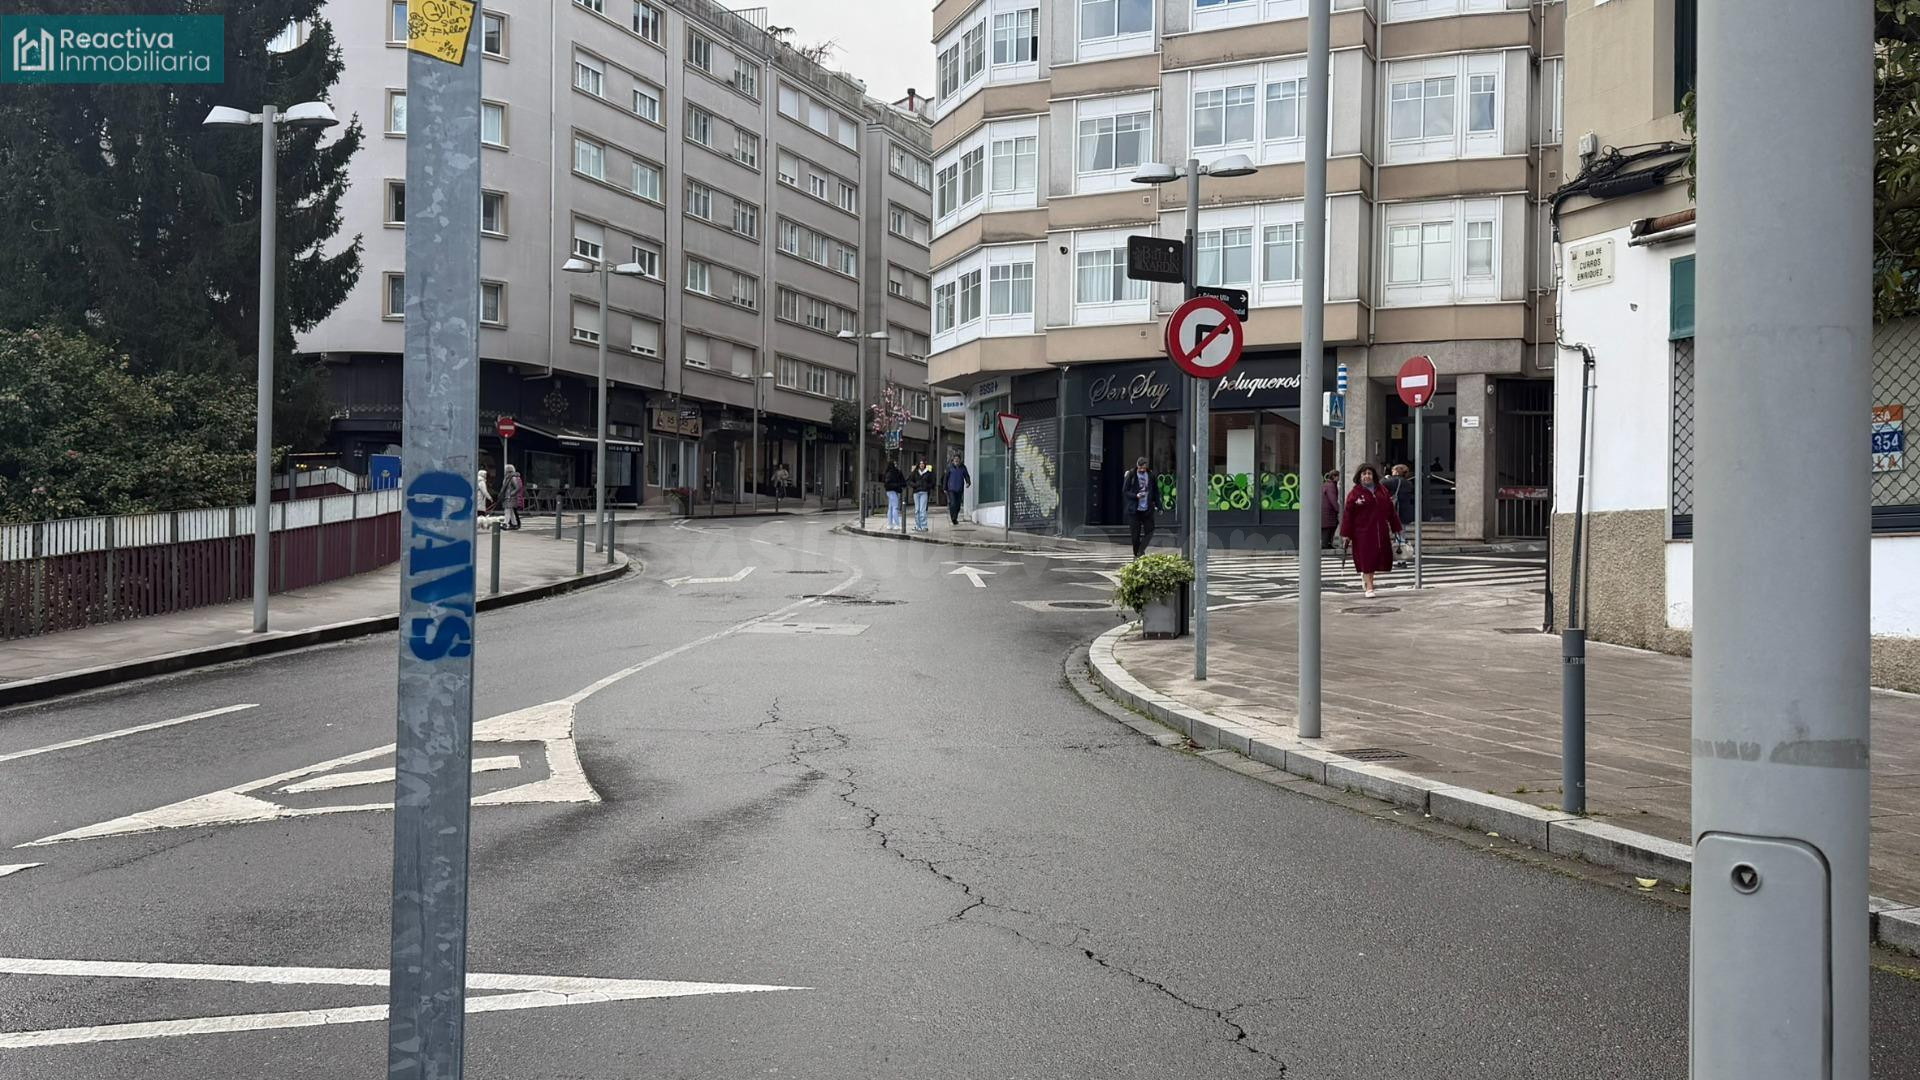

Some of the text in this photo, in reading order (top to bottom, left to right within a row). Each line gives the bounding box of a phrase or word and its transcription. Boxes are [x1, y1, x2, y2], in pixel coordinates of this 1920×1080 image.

[1577, 268, 1604, 281] ENRIQUEZ
[1579, 258, 1602, 271] CURROS
[1127, 369, 1171, 409] Say
[1212, 371, 1301, 400] peluqueros
[406, 471, 475, 662] GAVS
